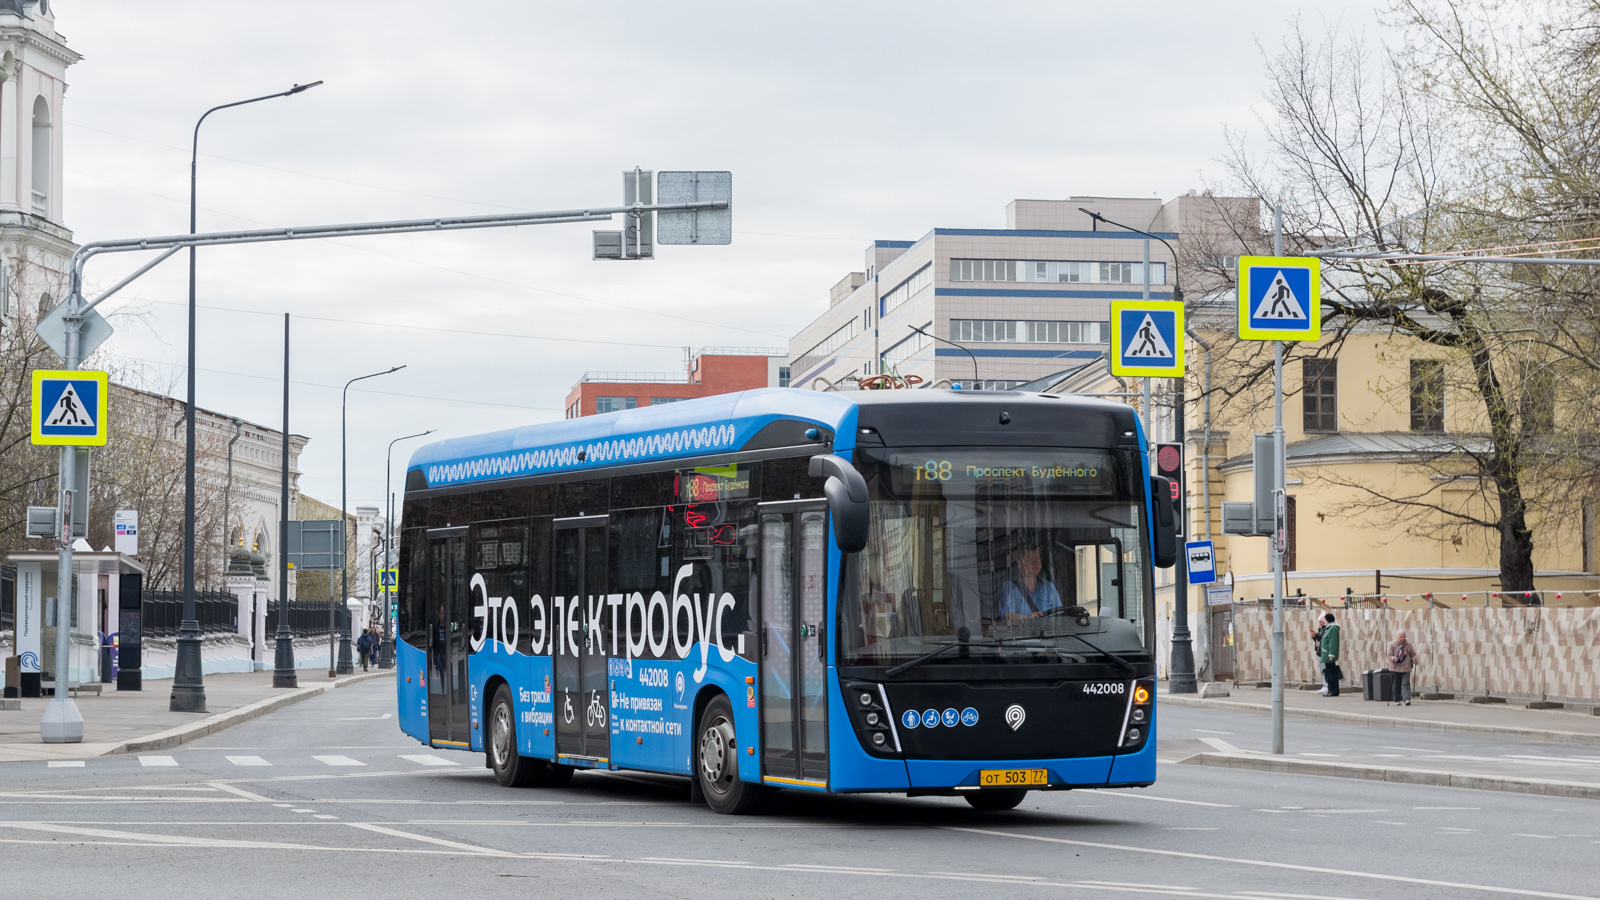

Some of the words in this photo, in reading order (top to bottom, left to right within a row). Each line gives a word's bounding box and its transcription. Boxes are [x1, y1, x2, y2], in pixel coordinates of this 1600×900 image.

[966, 465, 1026, 478] Проспект
[1032, 465, 1097, 478] Будённого
[469, 572, 519, 656] Это
[531, 562, 745, 684] электробус.
[639, 667, 669, 688] 442008
[519, 686, 530, 703] Без
[530, 690, 551, 707] тряски
[1083, 683, 1125, 695] 442008
[619, 692, 630, 710] Не
[630, 696, 663, 714] привязан
[525, 707, 552, 727] вибрации
[620, 718, 625, 731] к
[625, 717, 665, 734] контактной
[665, 721, 682, 736] сети
[1005, 771, 1026, 783] 503
[1033, 770, 1044, 780] 77
